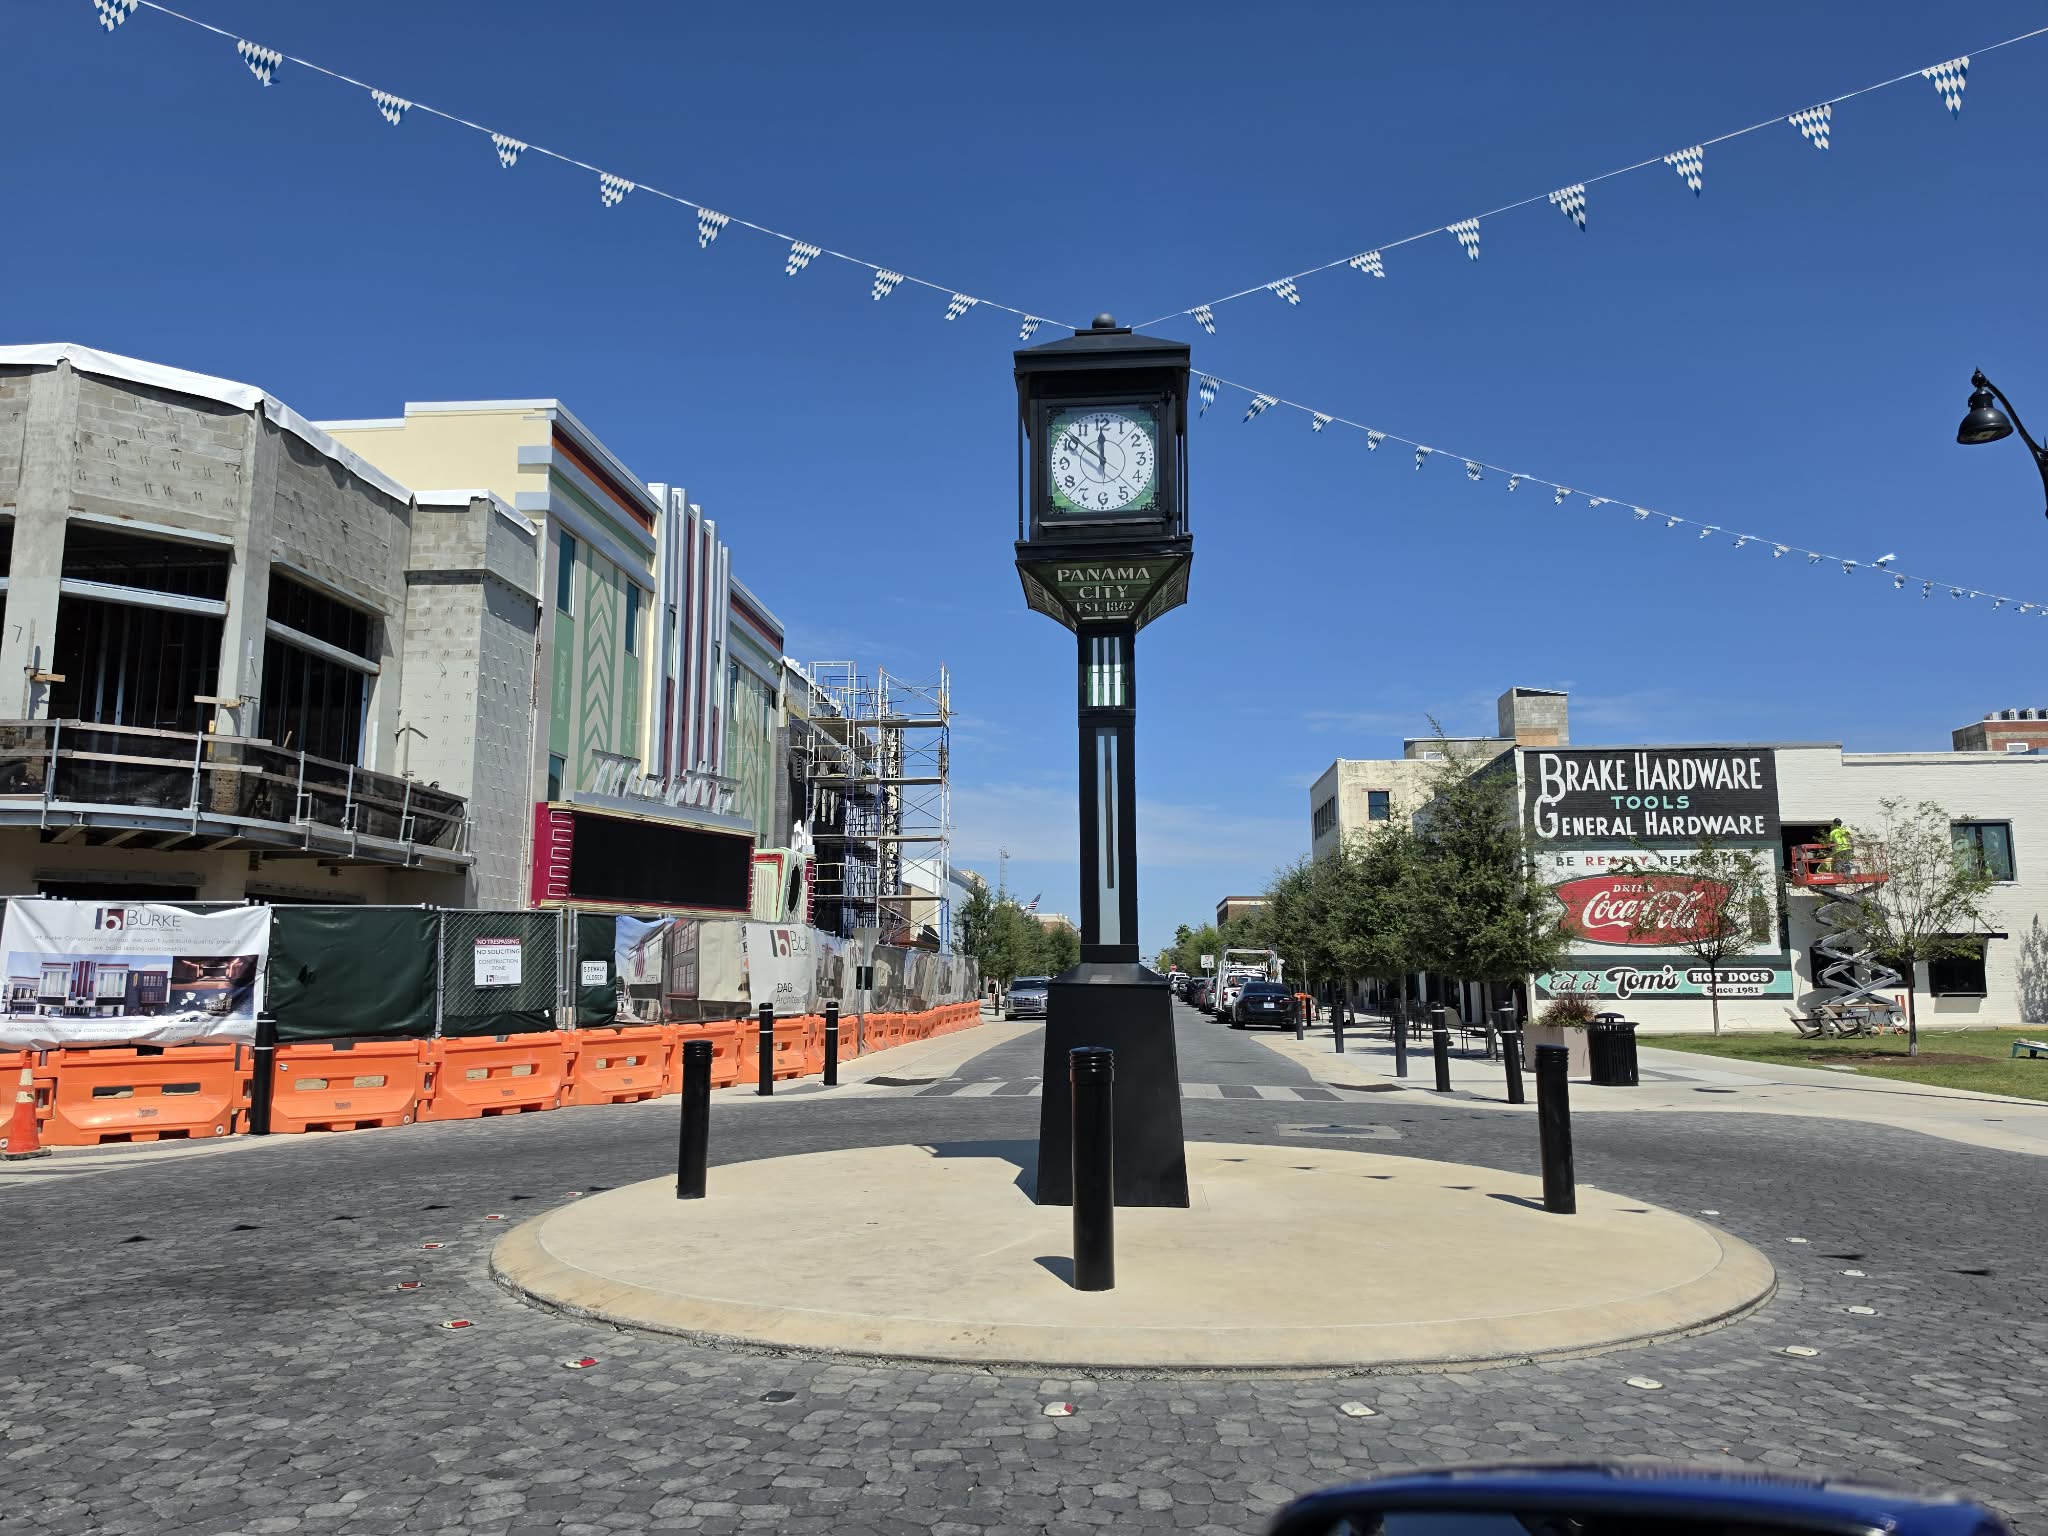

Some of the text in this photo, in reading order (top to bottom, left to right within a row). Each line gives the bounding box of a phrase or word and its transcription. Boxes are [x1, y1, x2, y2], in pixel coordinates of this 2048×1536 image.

[1078, 423, 1089, 437] 11
[1094, 417, 1111, 432] 12
[1118, 421, 1125, 435] 1
[1062, 436, 1079, 451] 10
[1130, 433, 1141, 448] 2
[1059, 456, 1071, 471] 9
[1135, 451, 1147, 466] 3
[1064, 475, 1076, 489] 8
[1132, 469, 1143, 483] 4
[1078, 487, 1089, 502] 7
[1097, 491, 1109, 506] 6
[1118, 486, 1129, 500] 5
[1057, 567, 1151, 582] PANAMA
[1079, 585, 1129, 599] CITY
[1076, 601, 1103, 612] EST.
[1539, 752, 1763, 804] BRAKE HARDWARE
[1610, 795, 1690, 810] TOOLS
[1533, 794, 1766, 839] GENERAL HARDWARE
[1556, 856, 1575, 867] BE
[127, 909, 184, 928] BURKE
[776, 982, 793, 993] DAG
[1548, 964, 1769, 999] Eat at Tom's HOT DOGS
[1735, 986, 1760, 994] 1981
